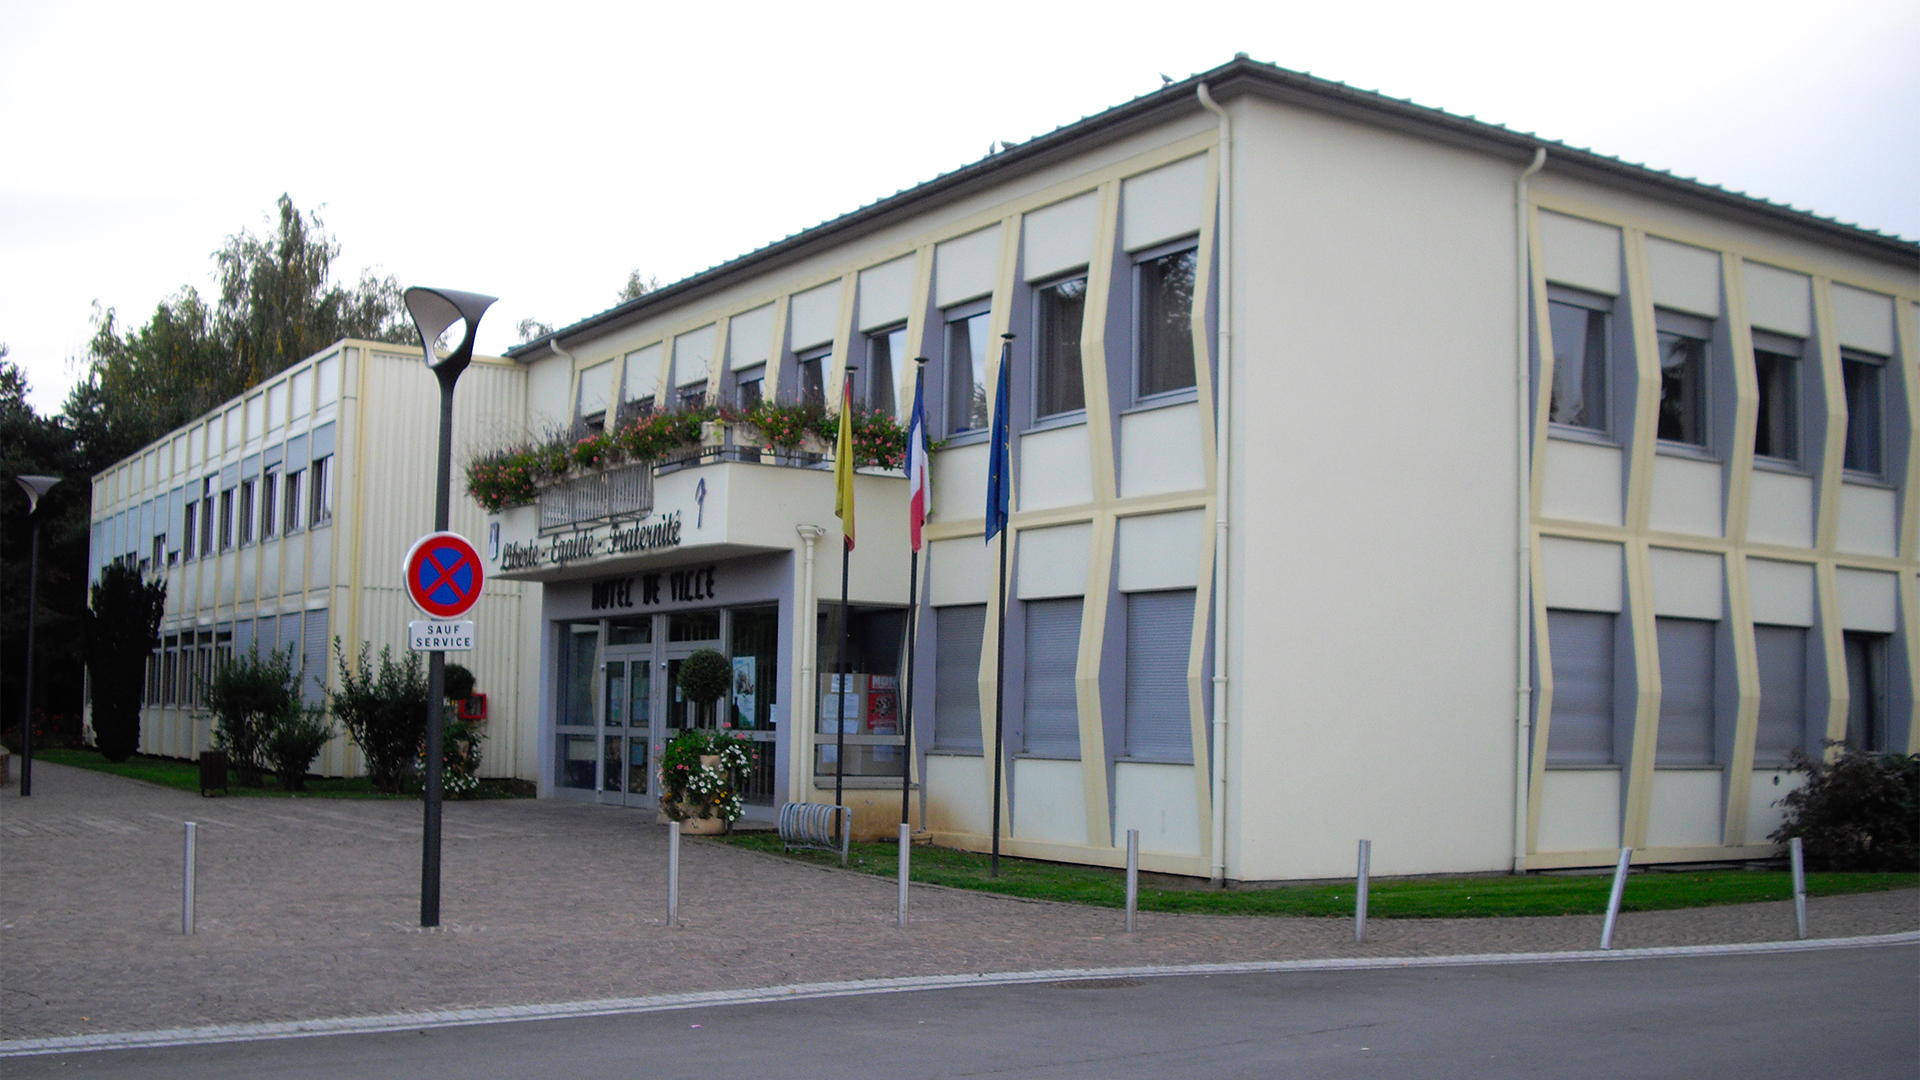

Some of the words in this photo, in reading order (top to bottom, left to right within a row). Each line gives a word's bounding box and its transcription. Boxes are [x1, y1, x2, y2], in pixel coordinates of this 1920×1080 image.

[608, 510, 681, 554] Fraternité
[642, 573, 661, 605] DE
[670, 565, 717, 602] VILLE
[416, 637, 471, 647] SERVICE
[427, 625, 460, 635] SAUF
